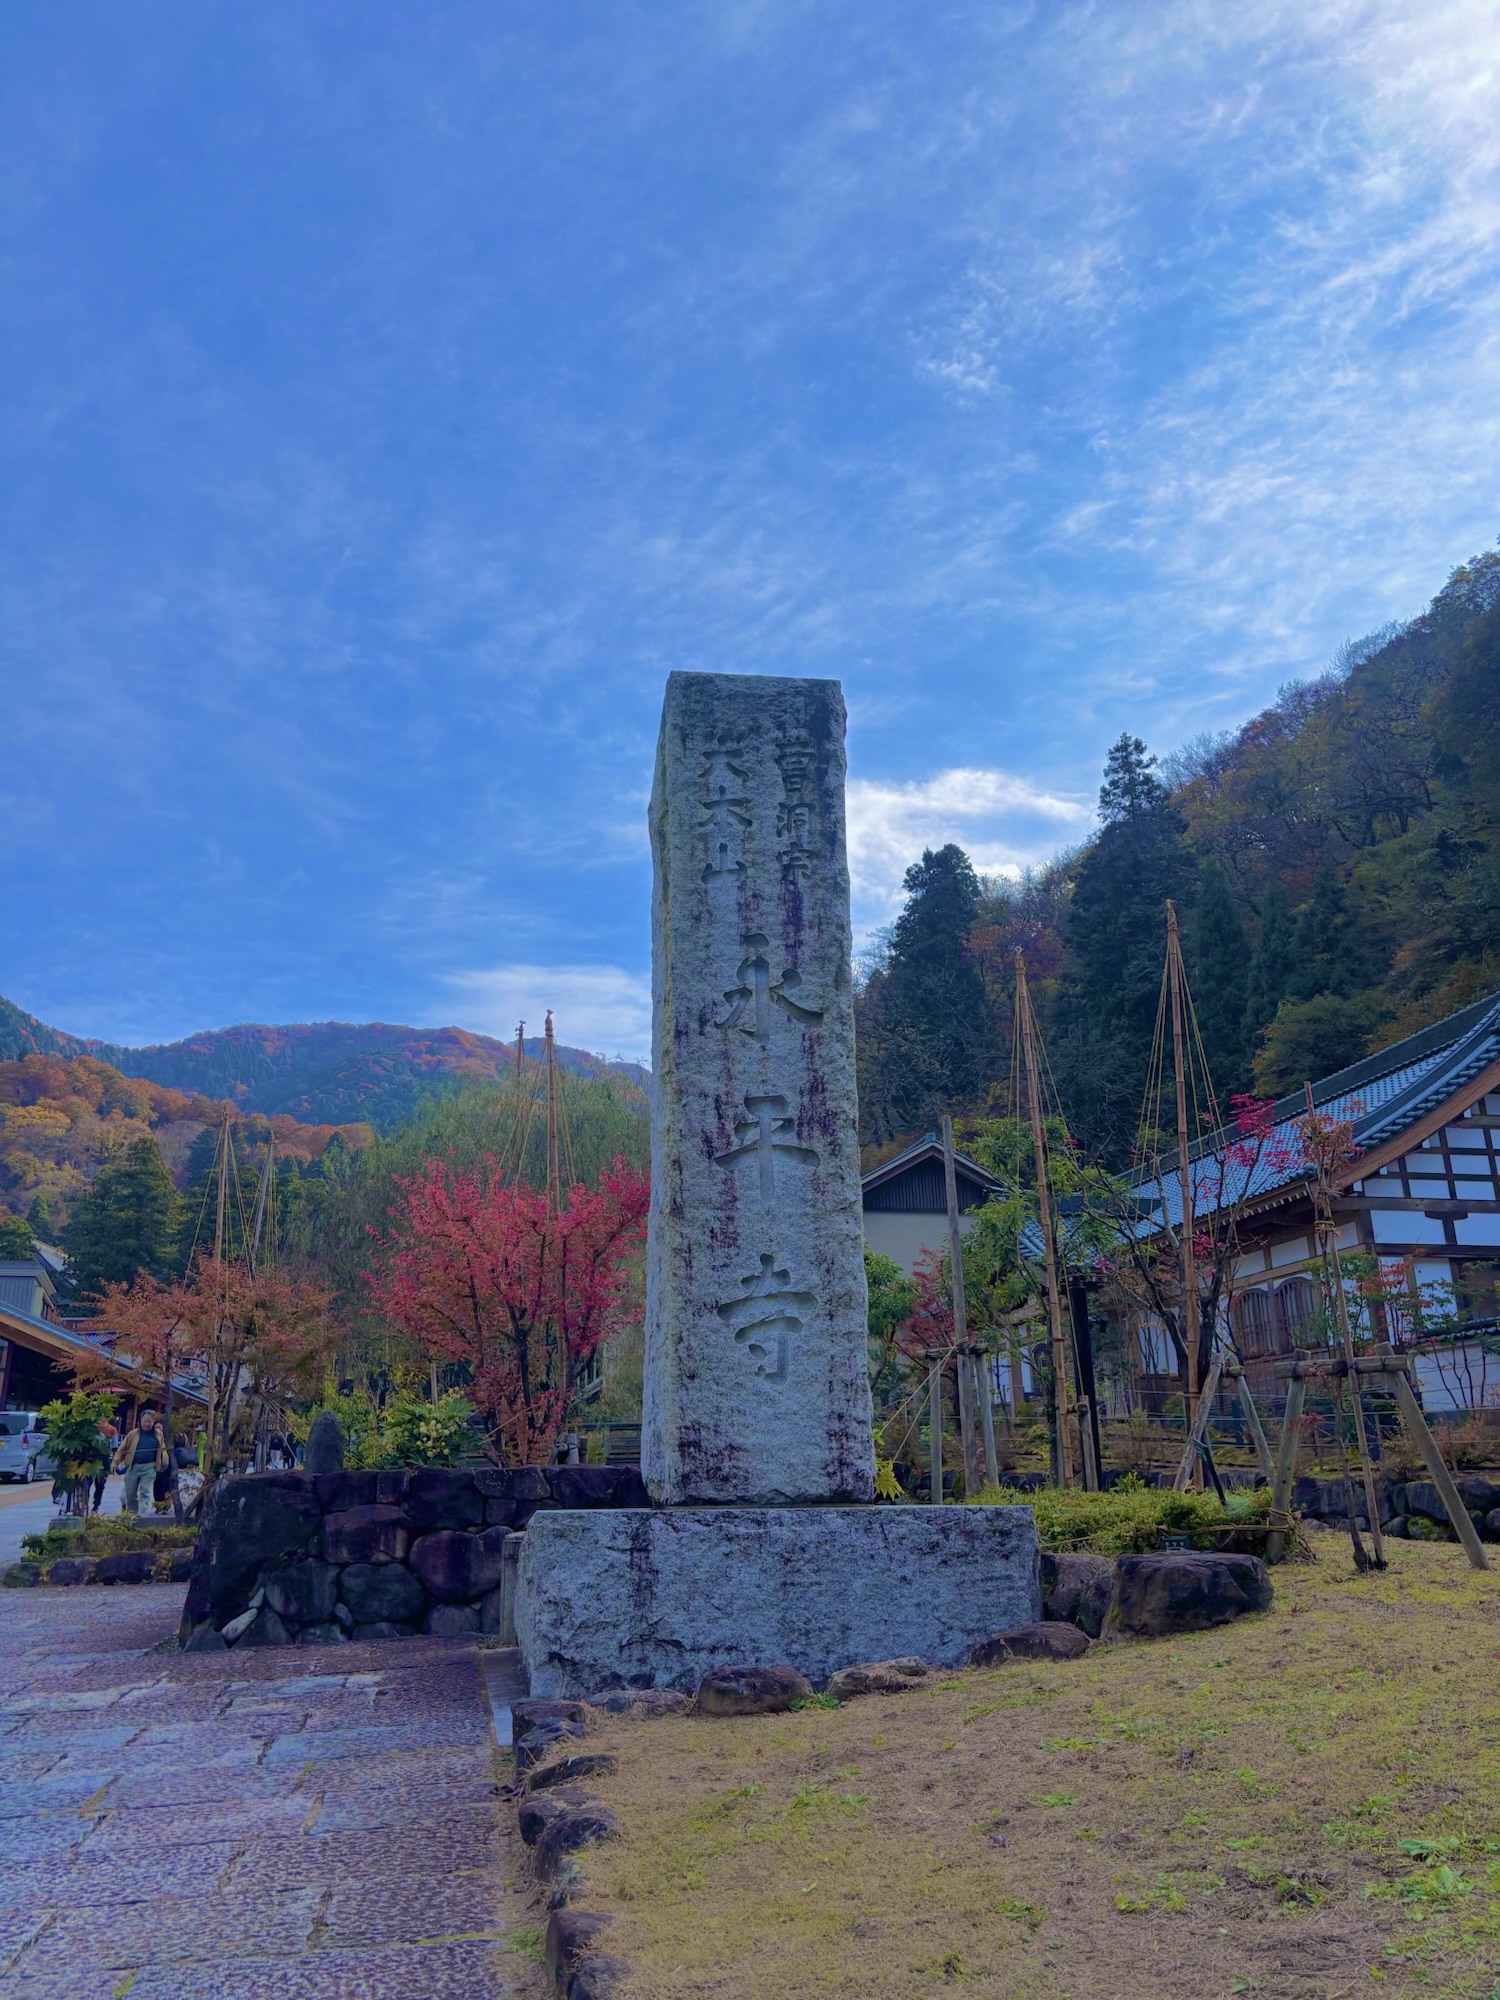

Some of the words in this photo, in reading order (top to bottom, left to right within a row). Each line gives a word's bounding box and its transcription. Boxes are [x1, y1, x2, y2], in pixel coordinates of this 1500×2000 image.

[697, 733, 754, 885] 大本山
[774, 737, 820, 883] 曹洞宗
[713, 932, 825, 1387] 永平寺
